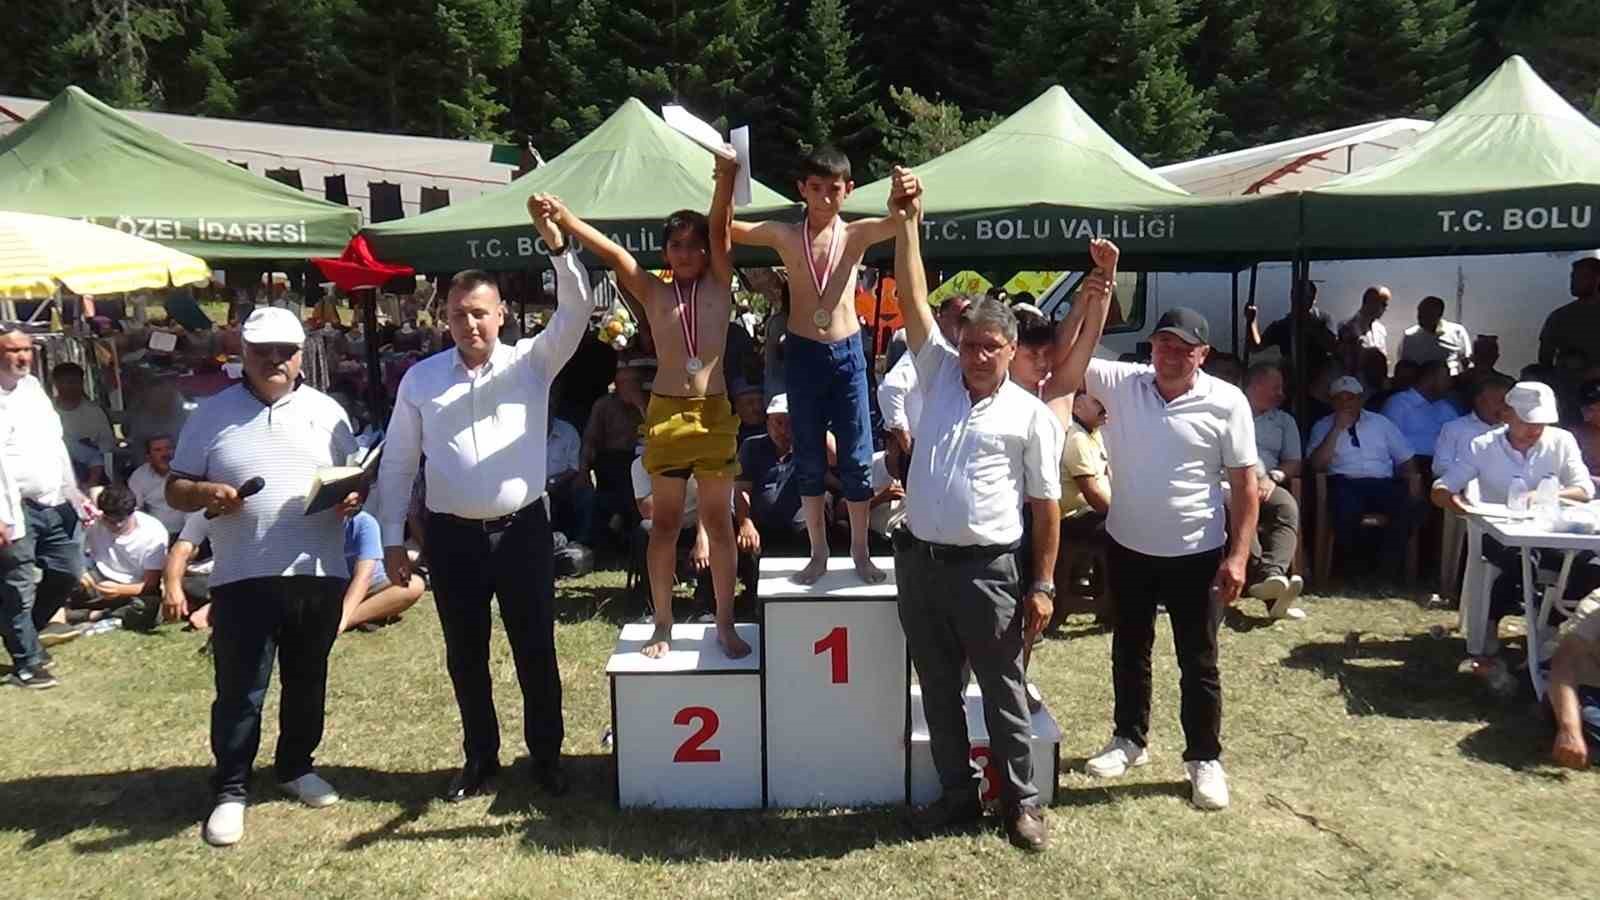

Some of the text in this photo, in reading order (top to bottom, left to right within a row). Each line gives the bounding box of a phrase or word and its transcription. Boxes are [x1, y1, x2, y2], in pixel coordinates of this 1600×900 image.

[115, 215, 307, 243] ÖZEL İDARESİ
[921, 214, 1175, 241] T.C. BOLU VALİLİĞİ
[1437, 205, 1592, 233] T.C. BOLU
[467, 239, 509, 259] T.C.
[517, 234, 584, 256] BOU
[814, 627, 849, 684] 1
[672, 706, 721, 763] 2
